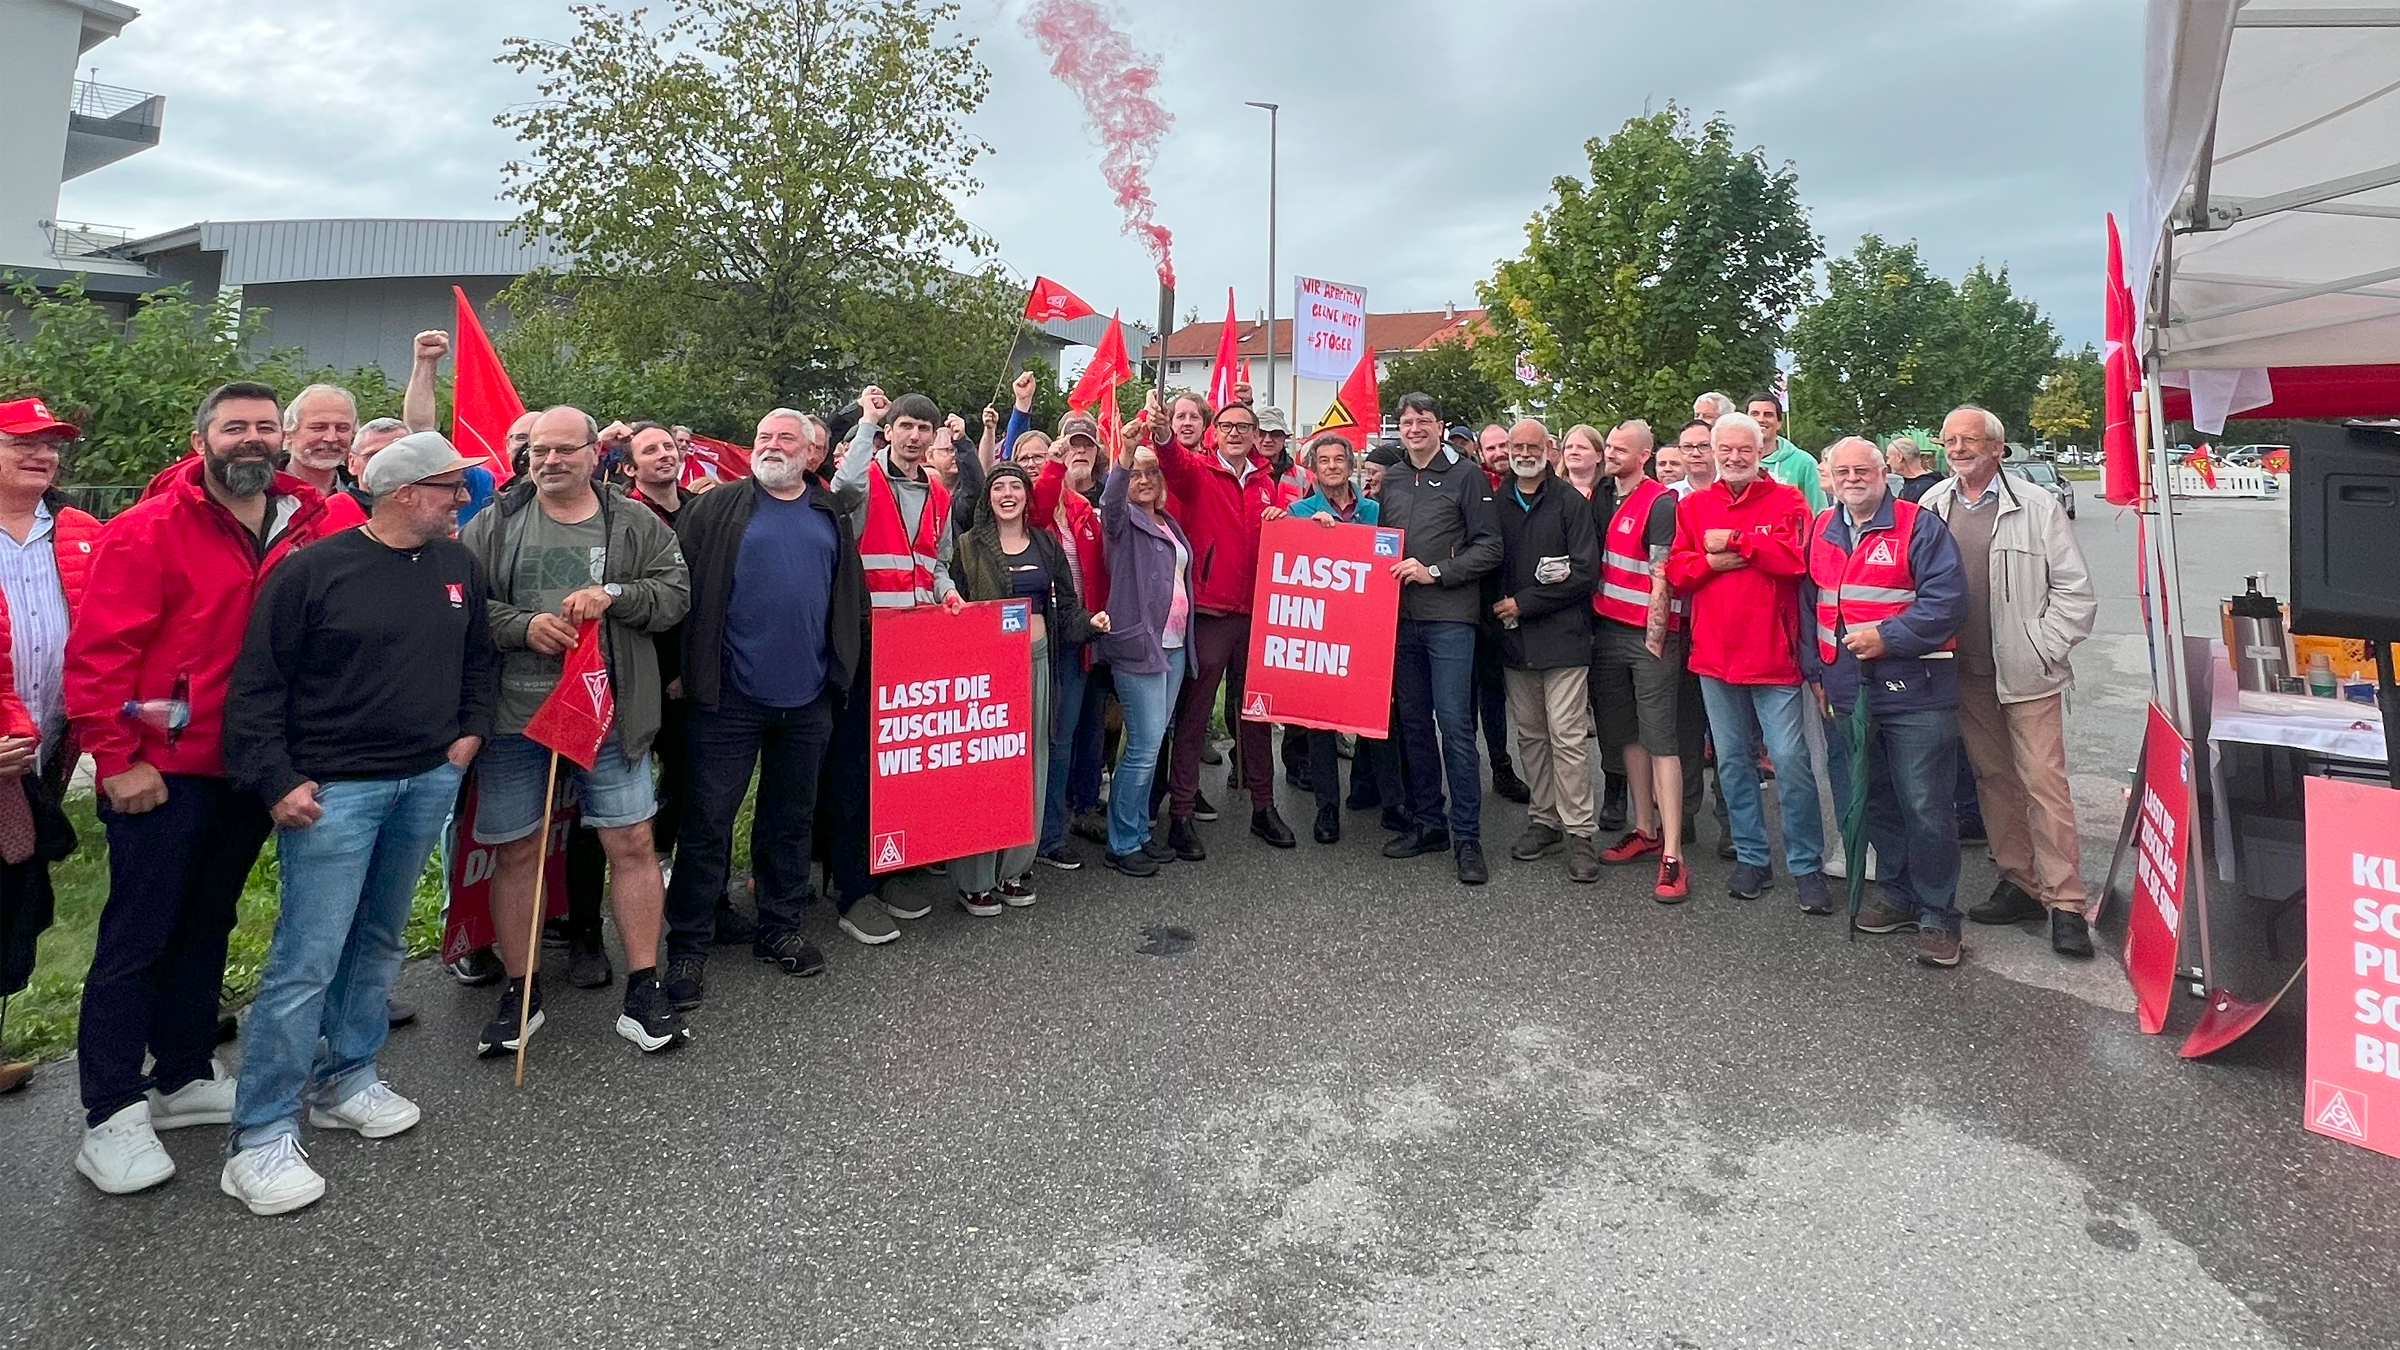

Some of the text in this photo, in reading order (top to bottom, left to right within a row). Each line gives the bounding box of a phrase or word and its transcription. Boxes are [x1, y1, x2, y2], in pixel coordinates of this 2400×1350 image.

[1301, 278, 1361, 308] WIR ARBEITEN
[1307, 330, 1352, 351] #STÖGER
[1271, 552, 1372, 593] LASST
[1268, 593, 1325, 631] IHN
[1263, 635, 1350, 677] REIN!
[878, 674, 991, 711] LASST DIE
[877, 701, 1009, 744] ZUSCHLÄGE
[877, 732, 1026, 777] WIE SIE SIND!
